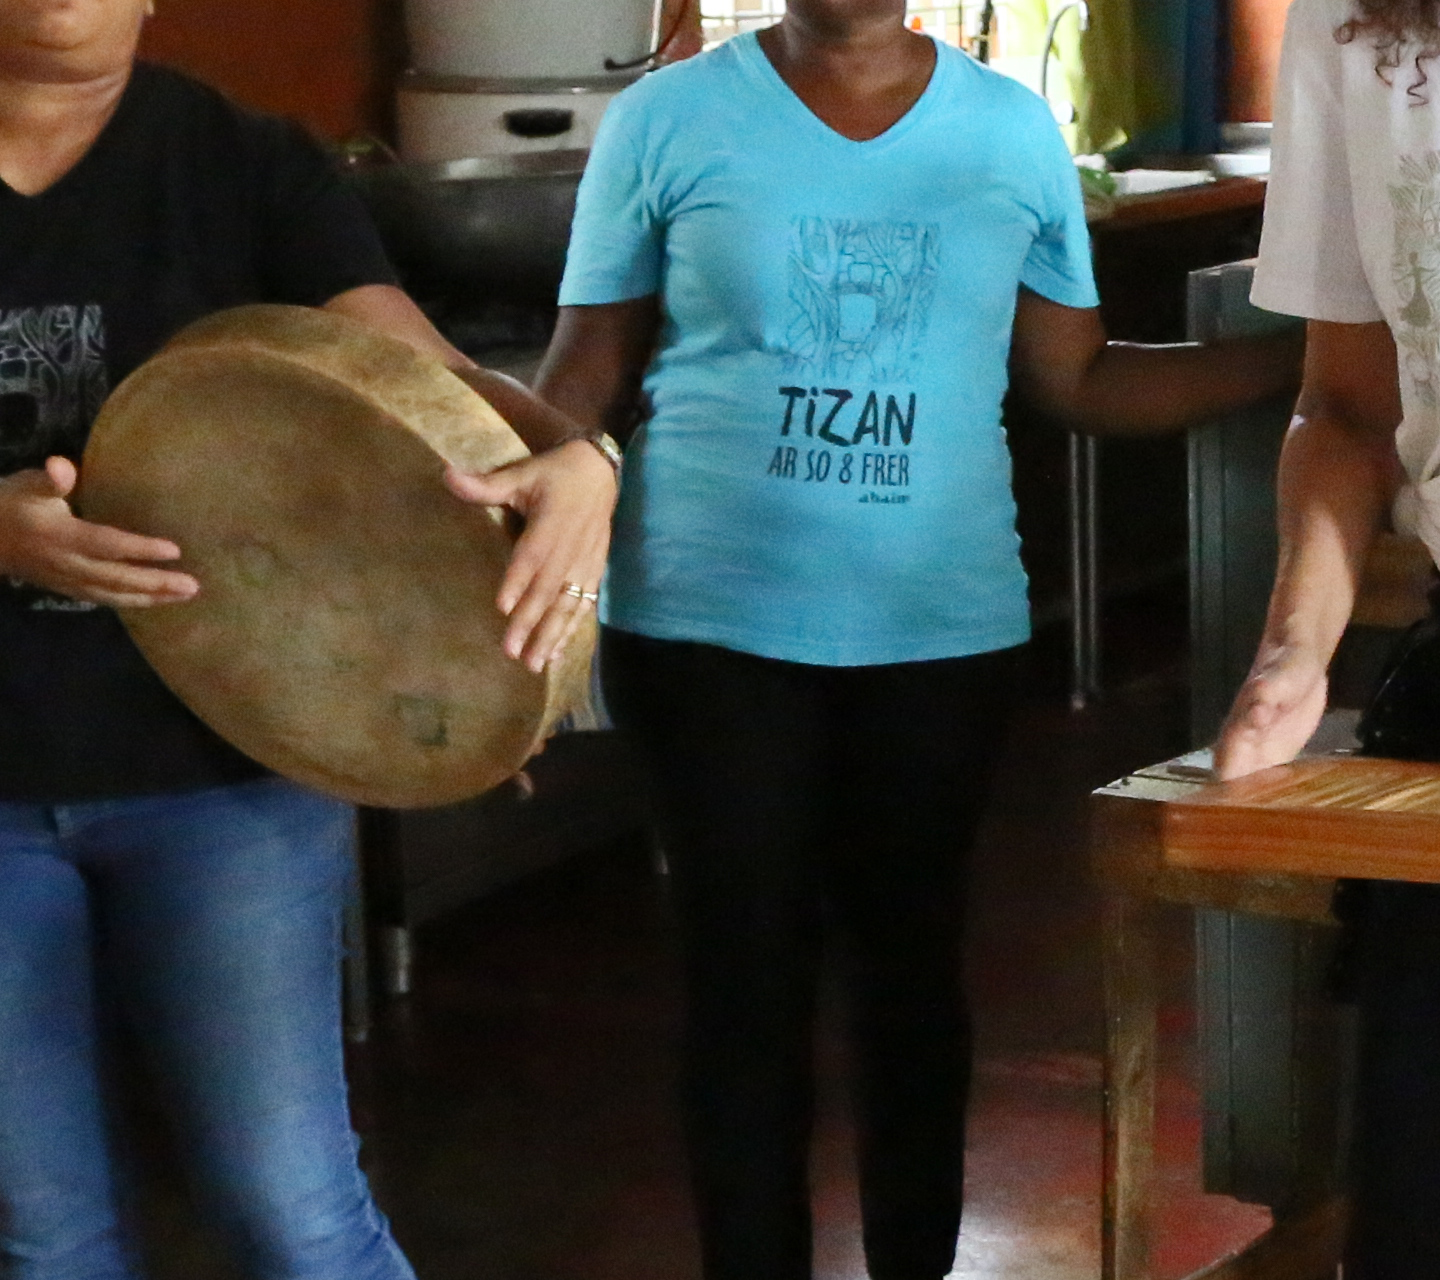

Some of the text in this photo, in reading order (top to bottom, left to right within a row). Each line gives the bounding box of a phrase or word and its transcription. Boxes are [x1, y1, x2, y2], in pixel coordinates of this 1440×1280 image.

[767, 446, 910, 487] AR SO 8 FRER
